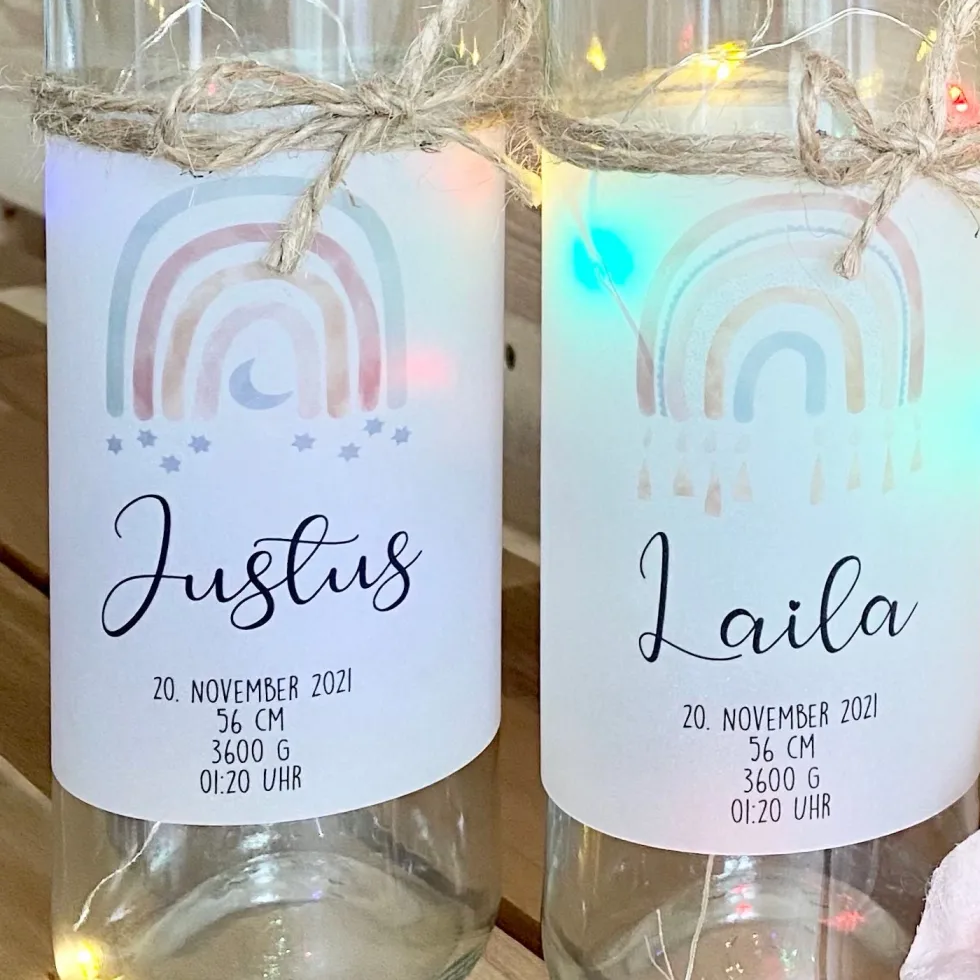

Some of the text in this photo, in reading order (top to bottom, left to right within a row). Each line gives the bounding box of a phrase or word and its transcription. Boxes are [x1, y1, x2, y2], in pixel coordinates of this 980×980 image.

[101, 493, 423, 638] Justus
[638, 531, 919, 663] Laila
[152, 667, 353, 704] 20. NOVEMBER 2021
[216, 706, 285, 734] 56 CM
[682, 692, 878, 732] 20. NOVEMBER 2021
[211, 738, 290, 765] 3600 G
[749, 733, 816, 762] 56 CM
[199, 764, 302, 795] 01:20 UHR
[743, 766, 820, 794] 3600 G
[730, 792, 832, 825] 01:20 UHR
